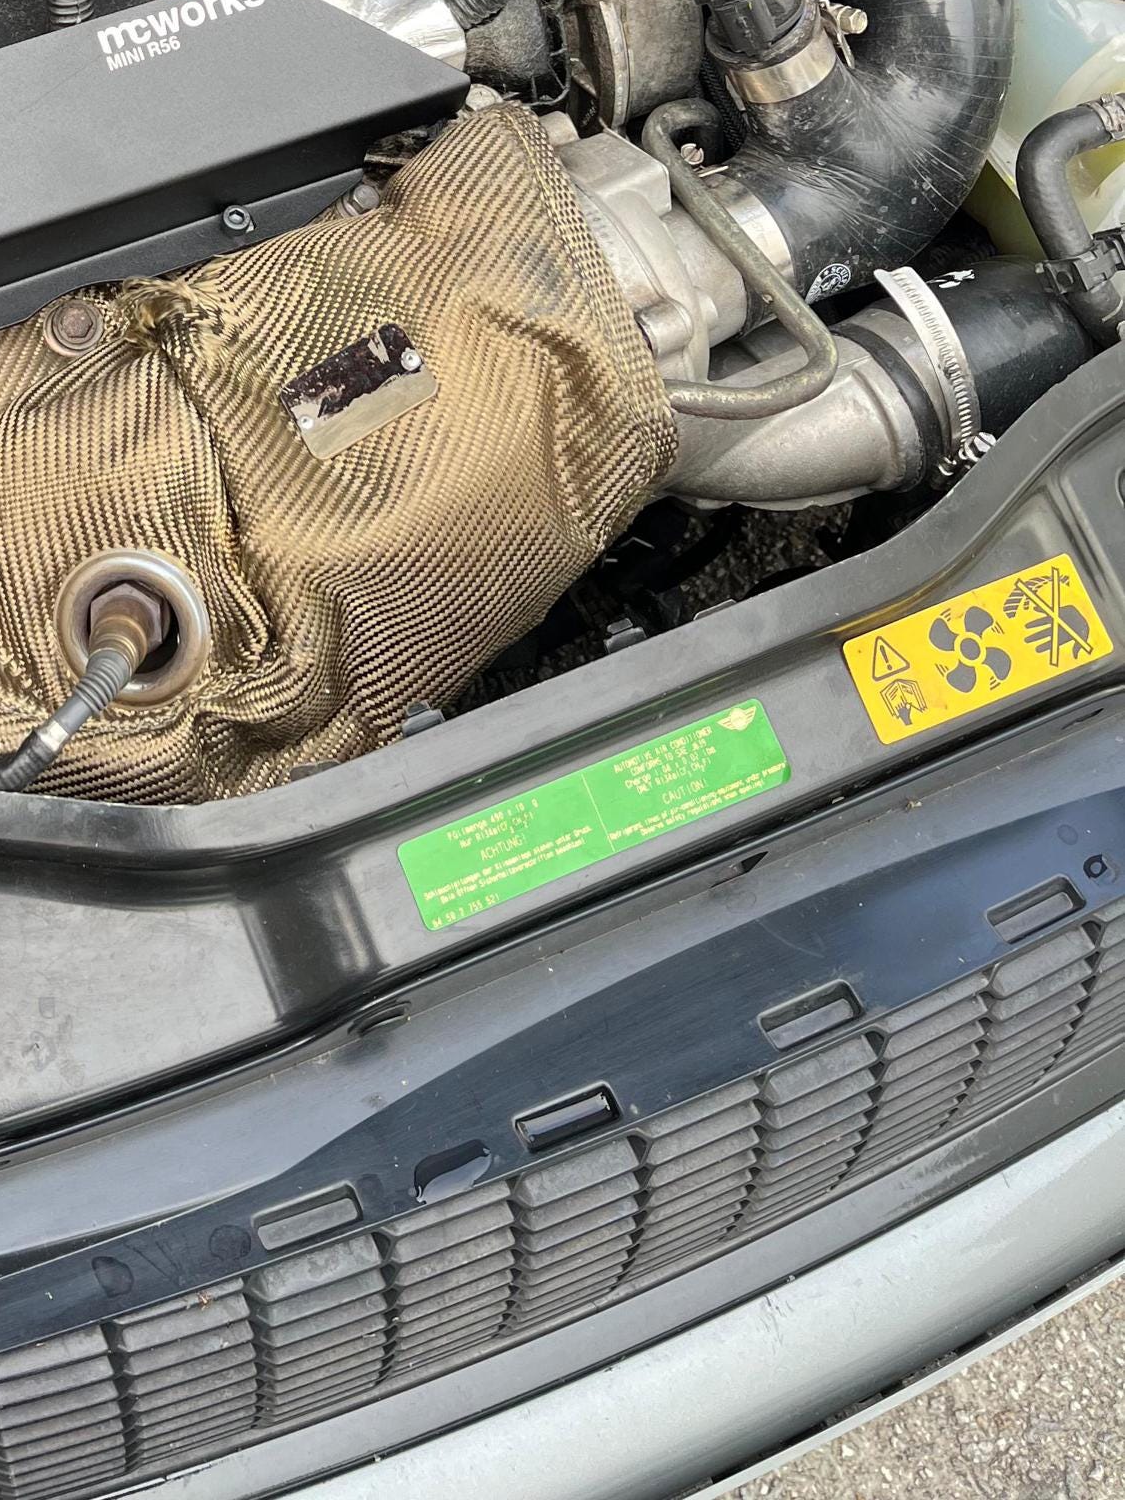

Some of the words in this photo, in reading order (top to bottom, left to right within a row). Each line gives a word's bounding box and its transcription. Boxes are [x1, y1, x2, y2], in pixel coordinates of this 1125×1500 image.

[106, 46, 145, 71] MINI
[146, 36, 181, 58] R56
[660, 776, 708, 804] CAUTION!
[478, 832, 528, 861] ACHTUNG!
